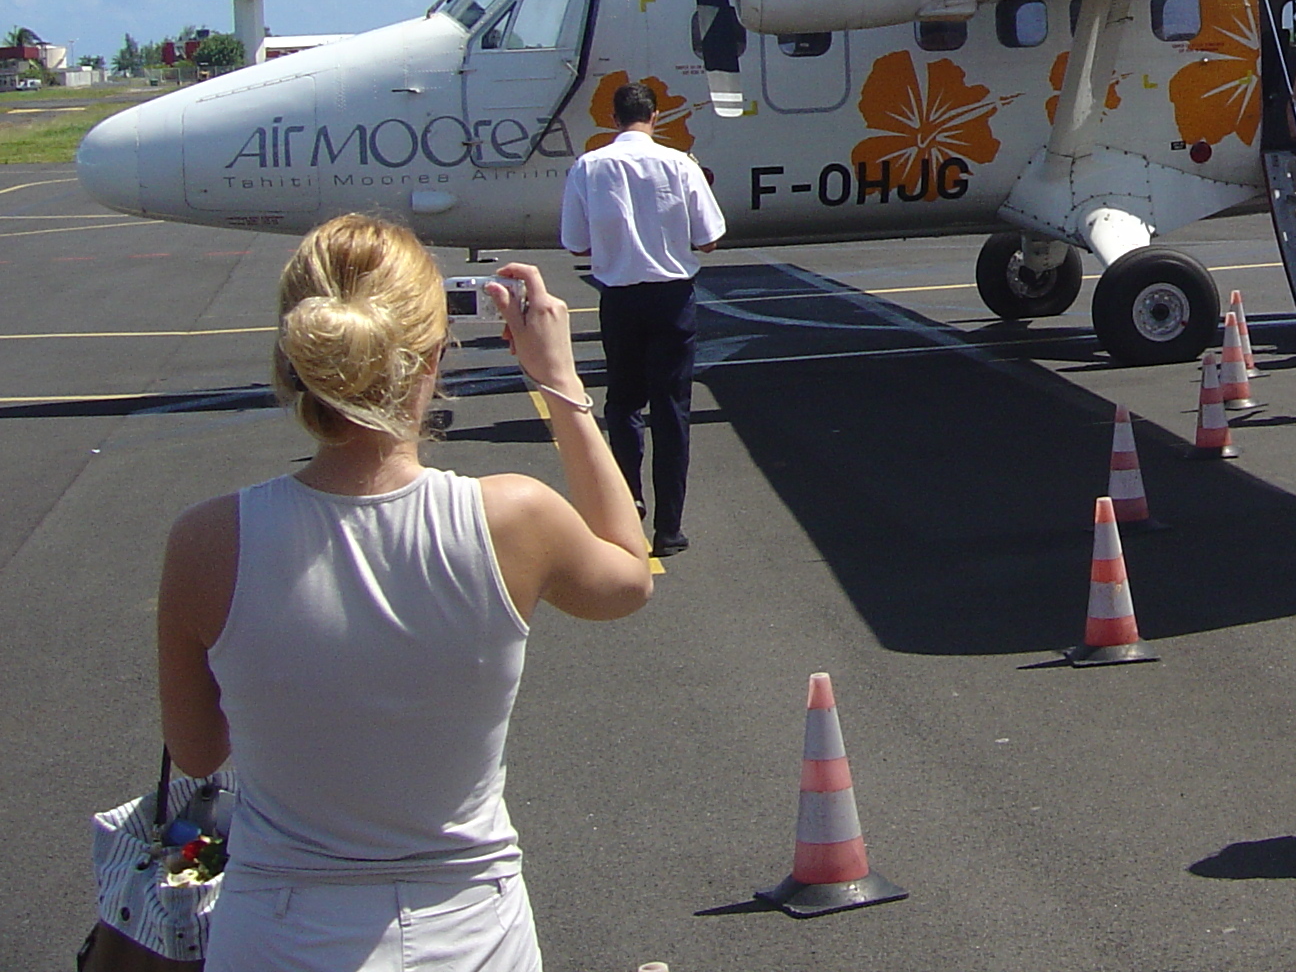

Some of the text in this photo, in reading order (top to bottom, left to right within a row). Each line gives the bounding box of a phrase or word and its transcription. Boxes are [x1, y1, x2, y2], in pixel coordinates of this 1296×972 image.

[223, 168, 571, 189] Tahiti Moorea Airlin
[750, 156, 970, 210] F-OHJG
